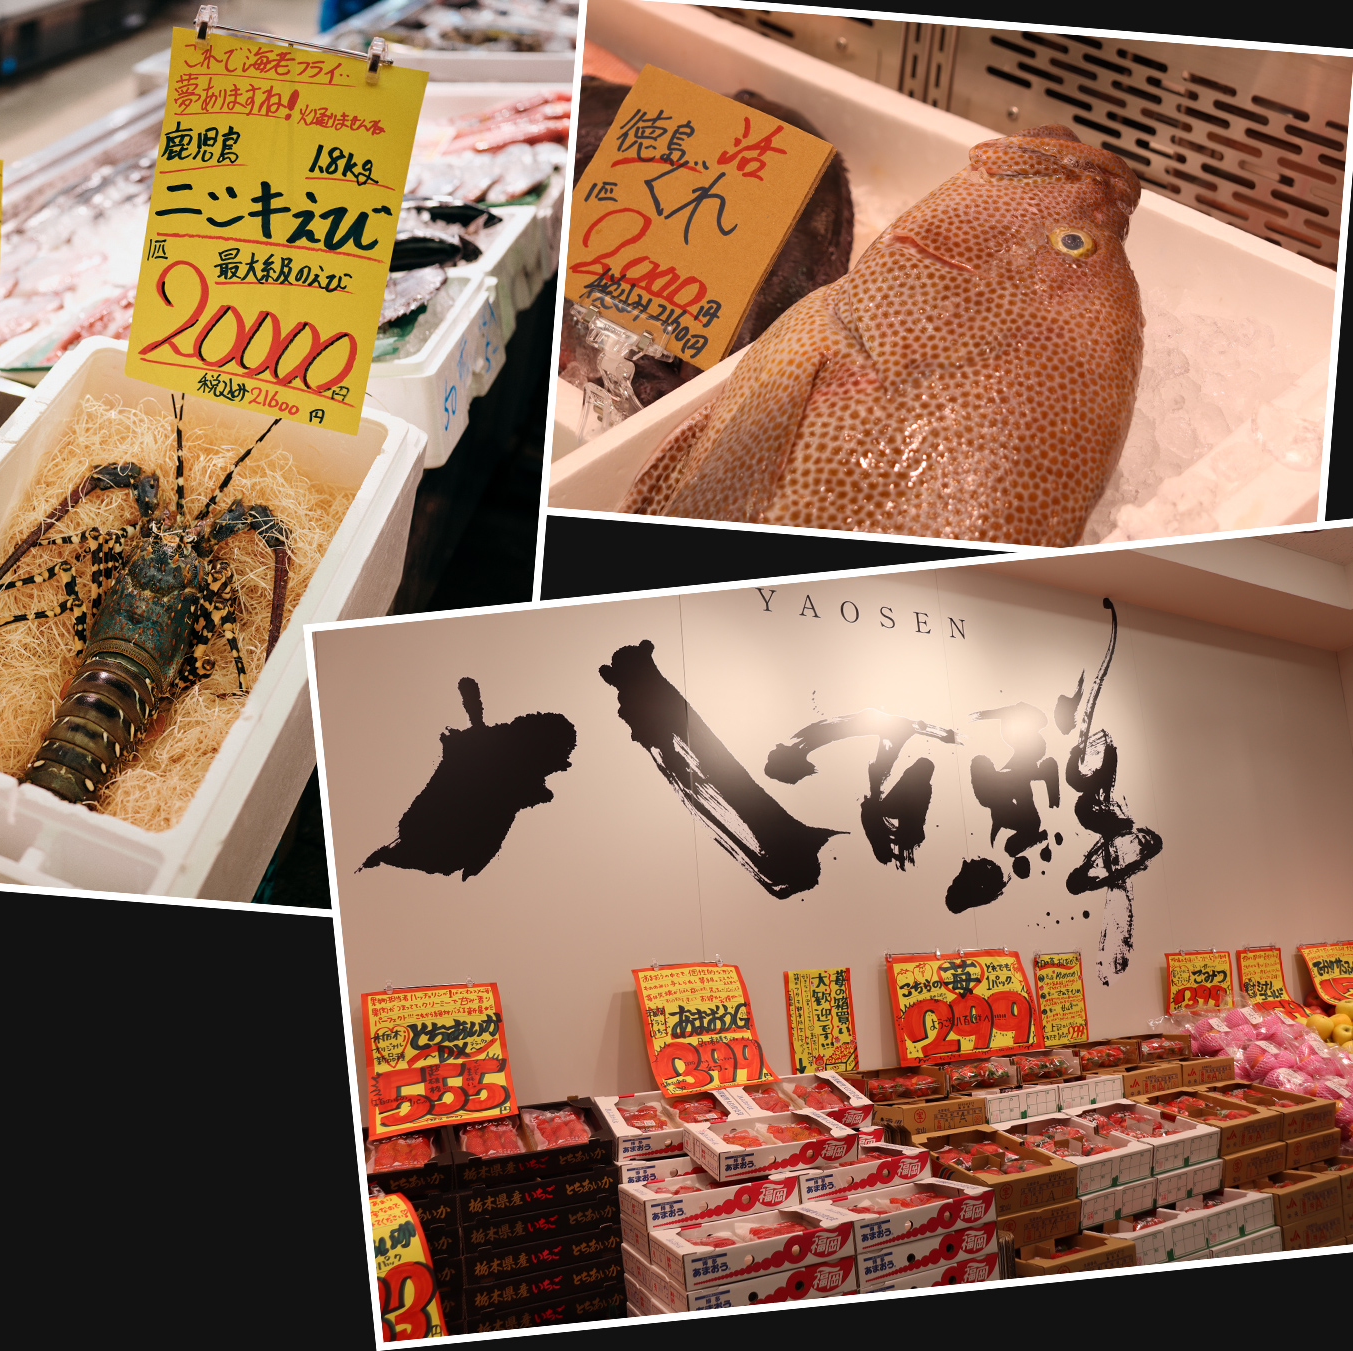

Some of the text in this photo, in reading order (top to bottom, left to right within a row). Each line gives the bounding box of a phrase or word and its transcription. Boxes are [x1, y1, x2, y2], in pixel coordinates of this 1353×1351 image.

[161, 120, 242, 164] 鹿児島
[616, 108, 695, 167] 徳島
[716, 116, 788, 182] 活
[154, 180, 393, 251] ニシキえび
[146, 238, 169, 261] 1匹
[213, 247, 353, 293] 最大級のえび
[755, 587, 966, 640] YAOSEN
[899, 959, 983, 1000] こちらの 苺
[1190, 969, 1228, 985] こみつ
[830, 969, 852, 1037] 苺の箱買い
[1173, 984, 1228, 1010] 399
[407, 1012, 503, 1051] とちあいか
[903, 989, 1033, 1058] 299
[377, 1057, 512, 1127] 555
[841, 1108, 865, 1126] 福岡
[622, 1143, 652, 1154] あまおう
[820, 1139, 848, 1159] 福岡
[463, 1147, 606, 1181] 栃木県産 いちご とちあいか
[725, 1160, 755, 1173] あまおう
[896, 1157, 922, 1177] 福岡
[389, 1172, 445, 1190] とちあいか
[805, 1182, 835, 1194] あまおう
[468, 1176, 614, 1213] 栃木県産 いちご とちあいか
[757, 1183, 788, 1204] 福岡
[651, 1209, 686, 1221] あまおう
[959, 1199, 987, 1219] 福岡
[470, 1205, 617, 1244] 栃木県産 いちご とちあいか
[860, 1229, 893, 1243] あまおう
[810, 1231, 842, 1253] 福岡
[961, 1228, 988, 1250] 福岡
[474, 1235, 621, 1277] 栃木県産 いちご とちあいか
[691, 1264, 729, 1279] あまおう
[812, 1265, 844, 1288] 福岡
[864, 1262, 897, 1276] あまおう
[963, 1261, 989, 1283] 福岡
[474, 1264, 621, 1308] 栃木県産 いちご とちあいか
[534, 1305, 566, 1323] いちご
[575, 1293, 624, 1315] とちあいか
